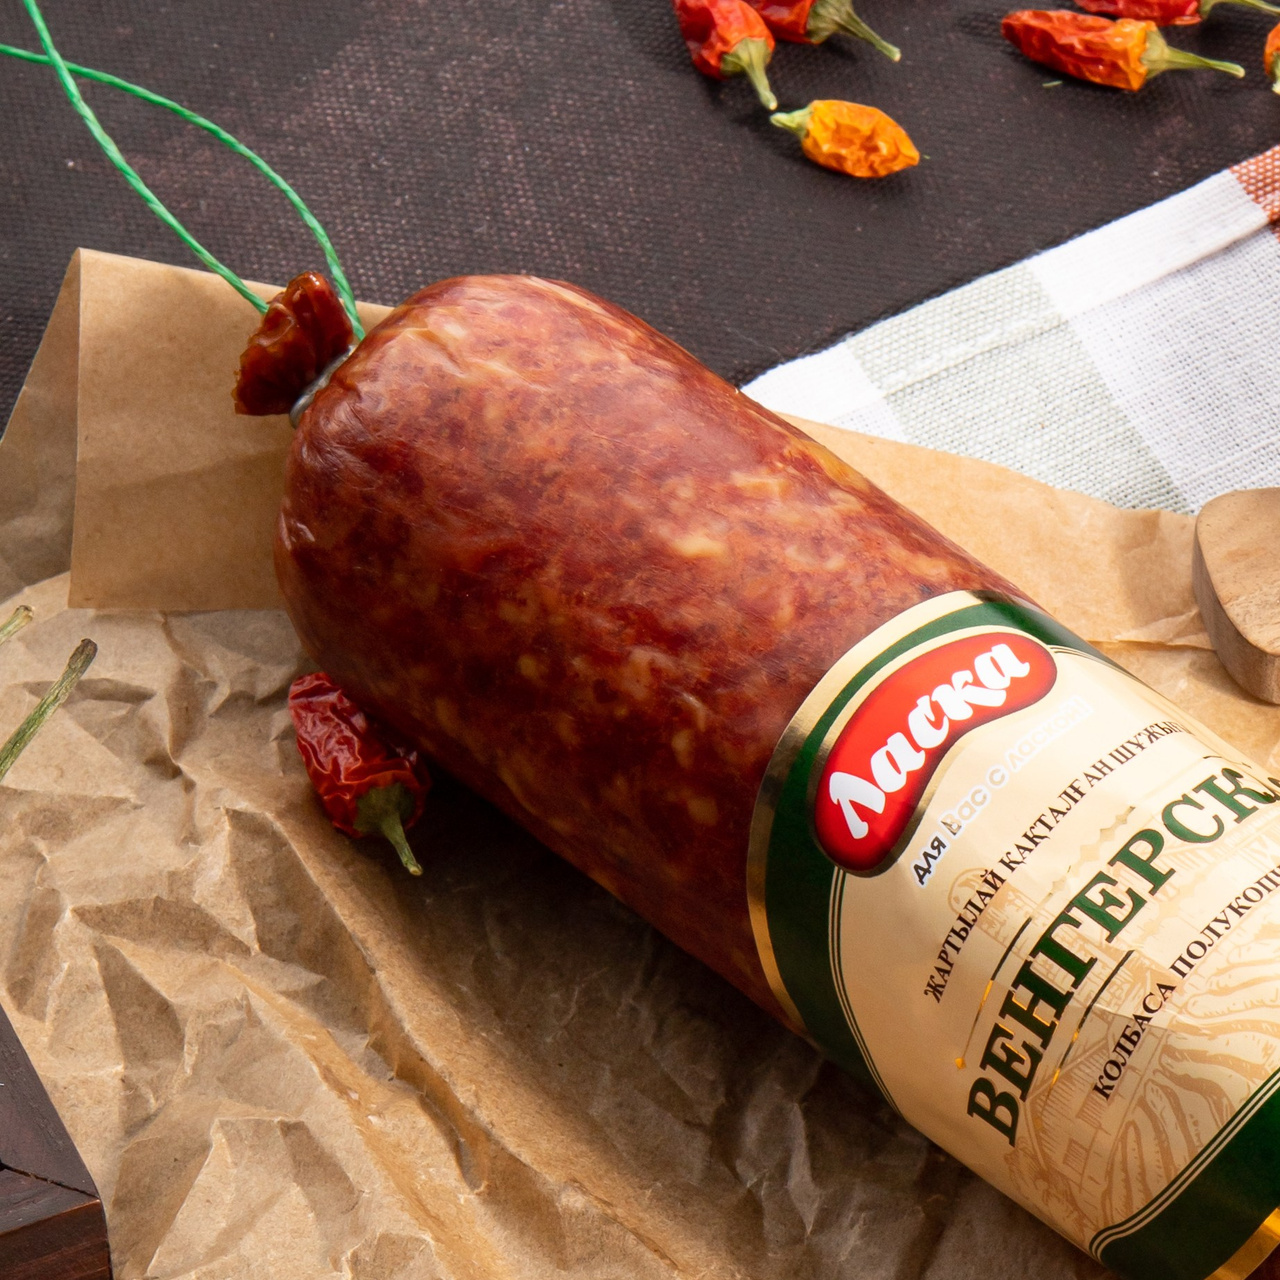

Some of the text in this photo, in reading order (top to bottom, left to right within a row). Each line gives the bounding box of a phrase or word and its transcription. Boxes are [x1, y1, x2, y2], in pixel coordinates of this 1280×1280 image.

[829, 643, 1031, 839] Ласка
[940, 788, 988, 836] Вас
[924, 869, 1006, 1003] ЖАРТЫЛАЙ
[1092, 981, 1177, 1101] КОЛБАСА
